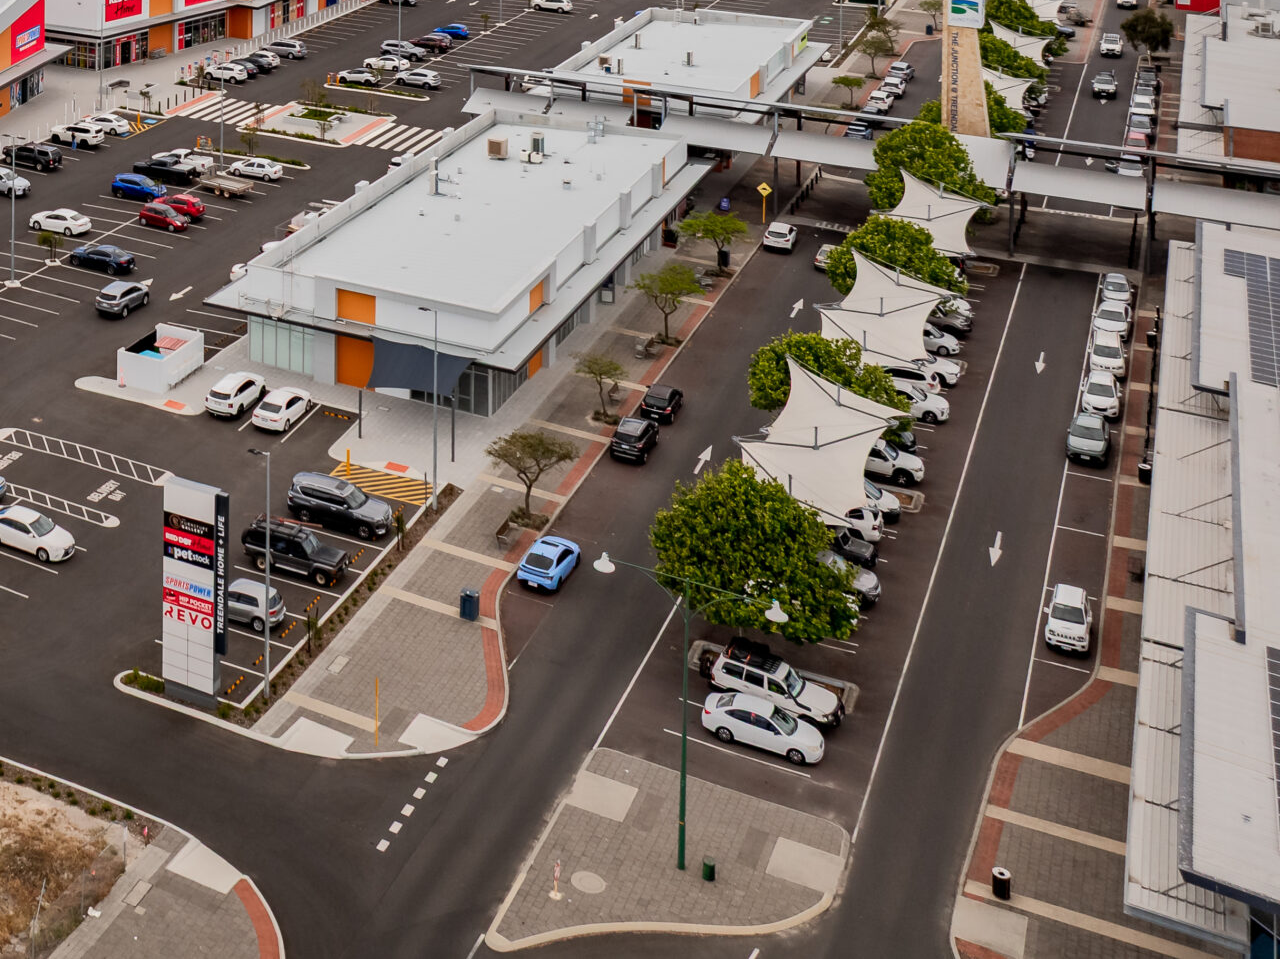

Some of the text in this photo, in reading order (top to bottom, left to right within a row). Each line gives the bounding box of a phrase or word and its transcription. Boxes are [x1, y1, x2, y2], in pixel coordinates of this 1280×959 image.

[951, 31, 959, 46] THE
[951, 47, 959, 85] JUNCTION
[950, 95, 958, 132] TREENDAL
[86, 479, 120, 502] DELIVERY
[108, 489, 127, 502] BAY
[165, 532, 178, 541] RED
[178, 536, 192, 546] DOT
[174, 546, 210, 565] petstock
[165, 576, 212, 598] SPORTSPOWER
[179, 595, 189, 603] HIP
[190, 598, 212, 611] POCKET
[164, 606, 212, 630] REVO
